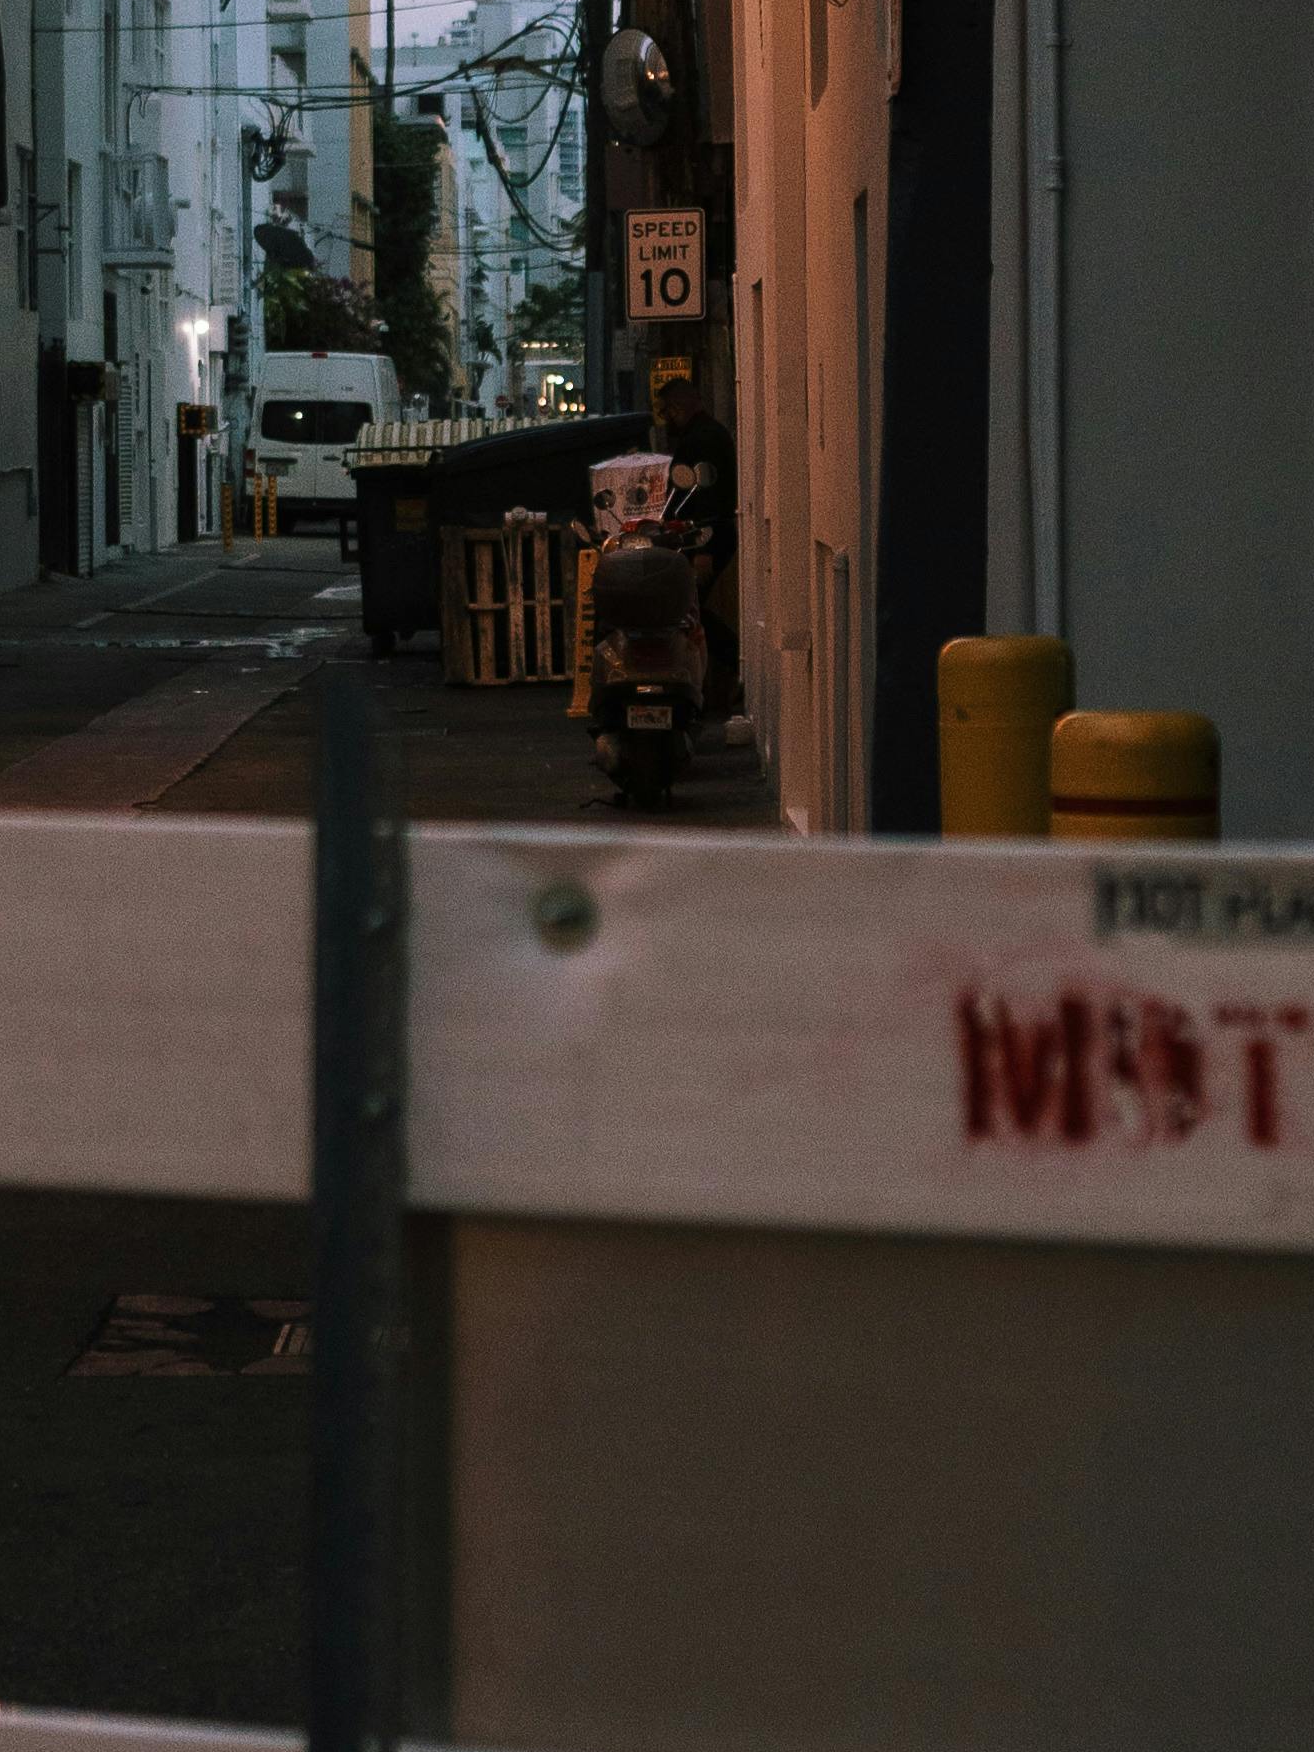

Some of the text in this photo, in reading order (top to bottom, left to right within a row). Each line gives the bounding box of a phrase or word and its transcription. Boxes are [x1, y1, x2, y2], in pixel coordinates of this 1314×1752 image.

[632, 221, 698, 239] SPEED
[639, 244, 690, 262] LIMIT
[640, 267, 691, 308] 10
